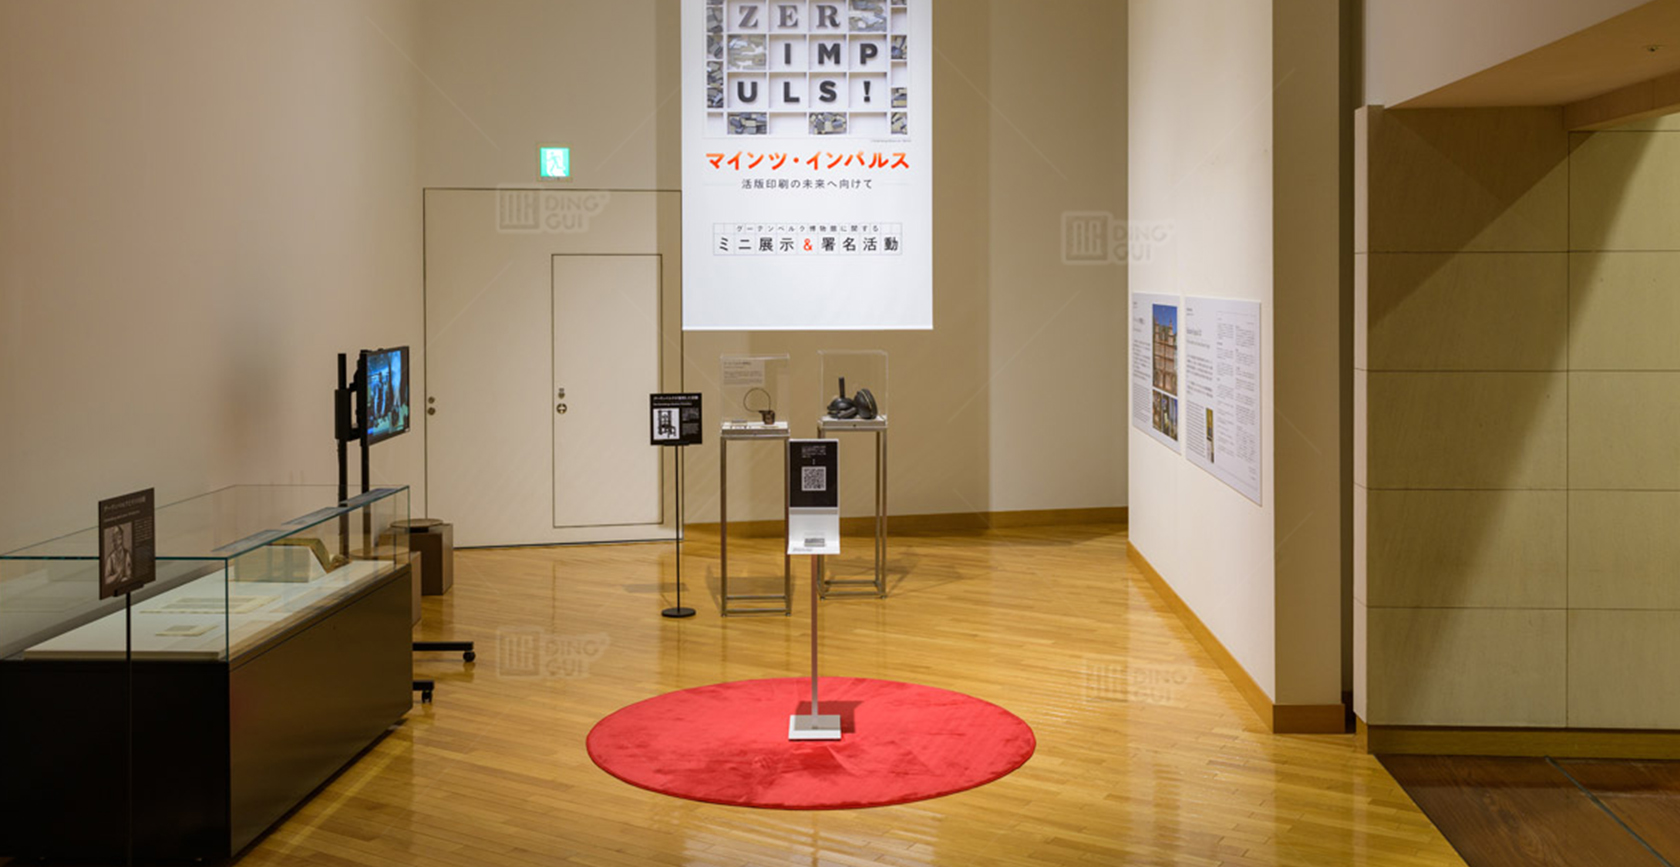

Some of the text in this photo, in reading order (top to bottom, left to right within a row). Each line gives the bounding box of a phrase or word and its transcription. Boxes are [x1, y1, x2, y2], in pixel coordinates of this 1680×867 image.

[738, 5, 841, 28] ZER
[784, 43, 878, 65] IMP
[737, 80, 871, 103] ULS!
[705, 151, 910, 170] マインツ・インパルス
[741, 178, 873, 190] 活版印刷の未来へ向けて
[719, 236, 899, 253] ミニ展示&署名活動
